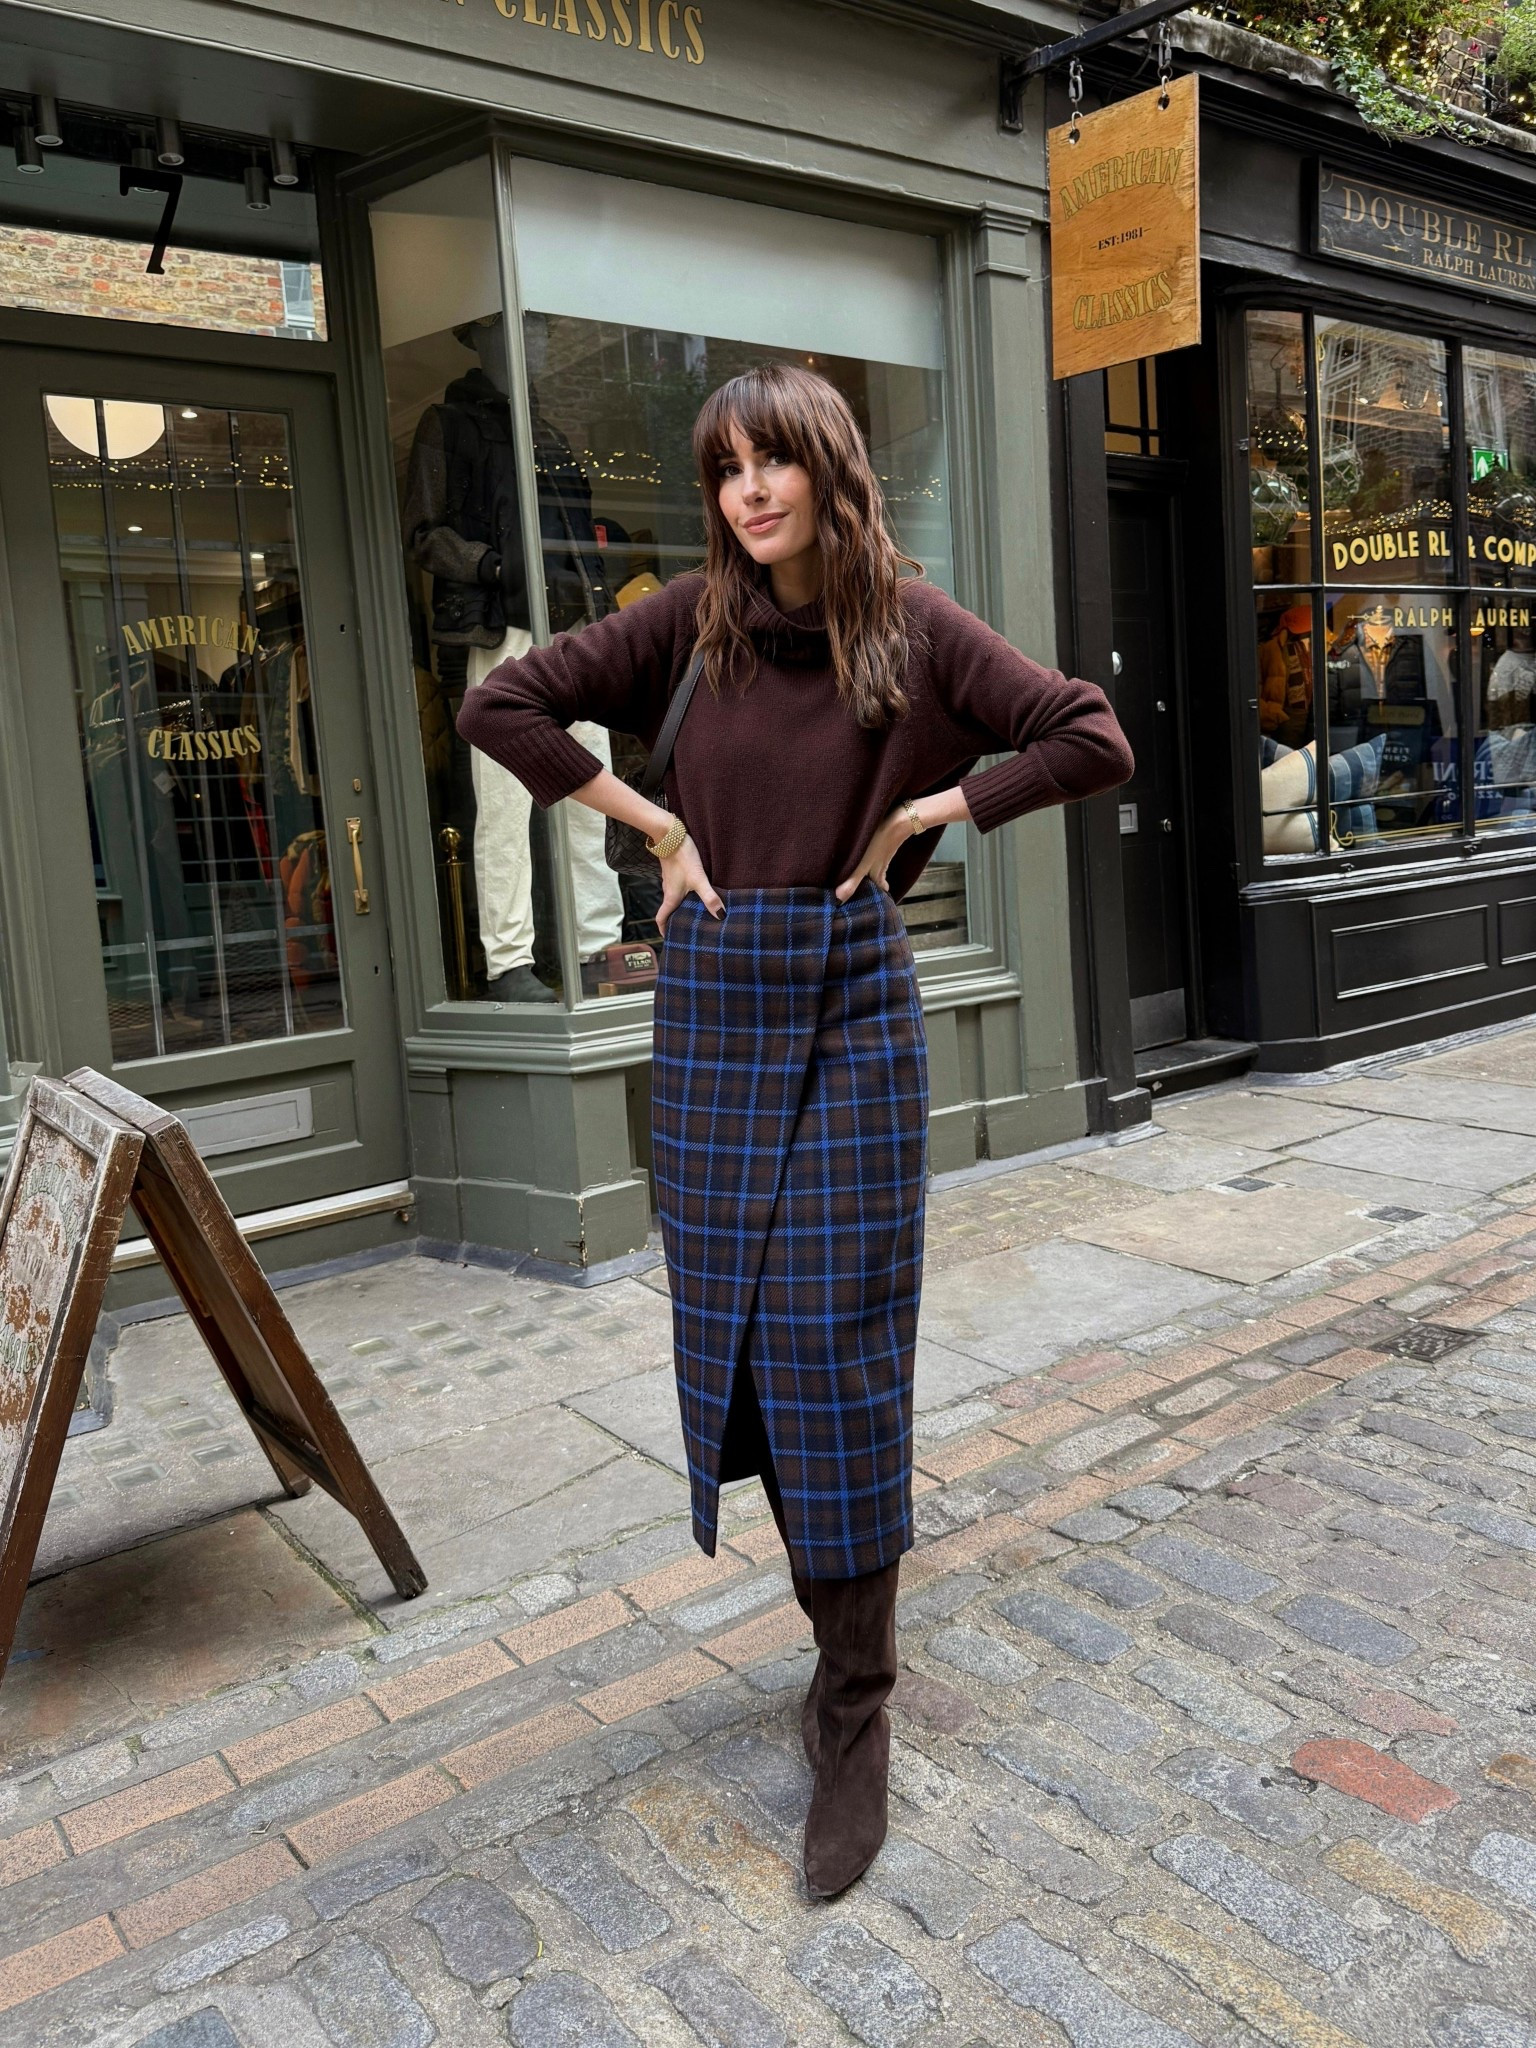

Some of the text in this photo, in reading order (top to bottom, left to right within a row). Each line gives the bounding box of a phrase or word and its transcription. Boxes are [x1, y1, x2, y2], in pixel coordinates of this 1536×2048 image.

[494, 0, 705, 65] ASSICS
[1059, 147, 1183, 221] AMERICAN
[119, 165, 183, 275] 7
[1098, 227, 1144, 250] EST:1981
[1342, 186, 1532, 268] DOUBLE RL
[1423, 248, 1536, 290] RALPH LAUREN
[1072, 270, 1173, 330] CLASSICS
[1332, 530, 1420, 571] DOUBLE
[1428, 530, 1451, 557] RL
[1484, 535, 1536, 567] COMP
[121, 615, 260, 656] AMERICAN
[1394, 608, 1530, 627] RALPH AUREN
[147, 724, 262, 761] CLASSICS
